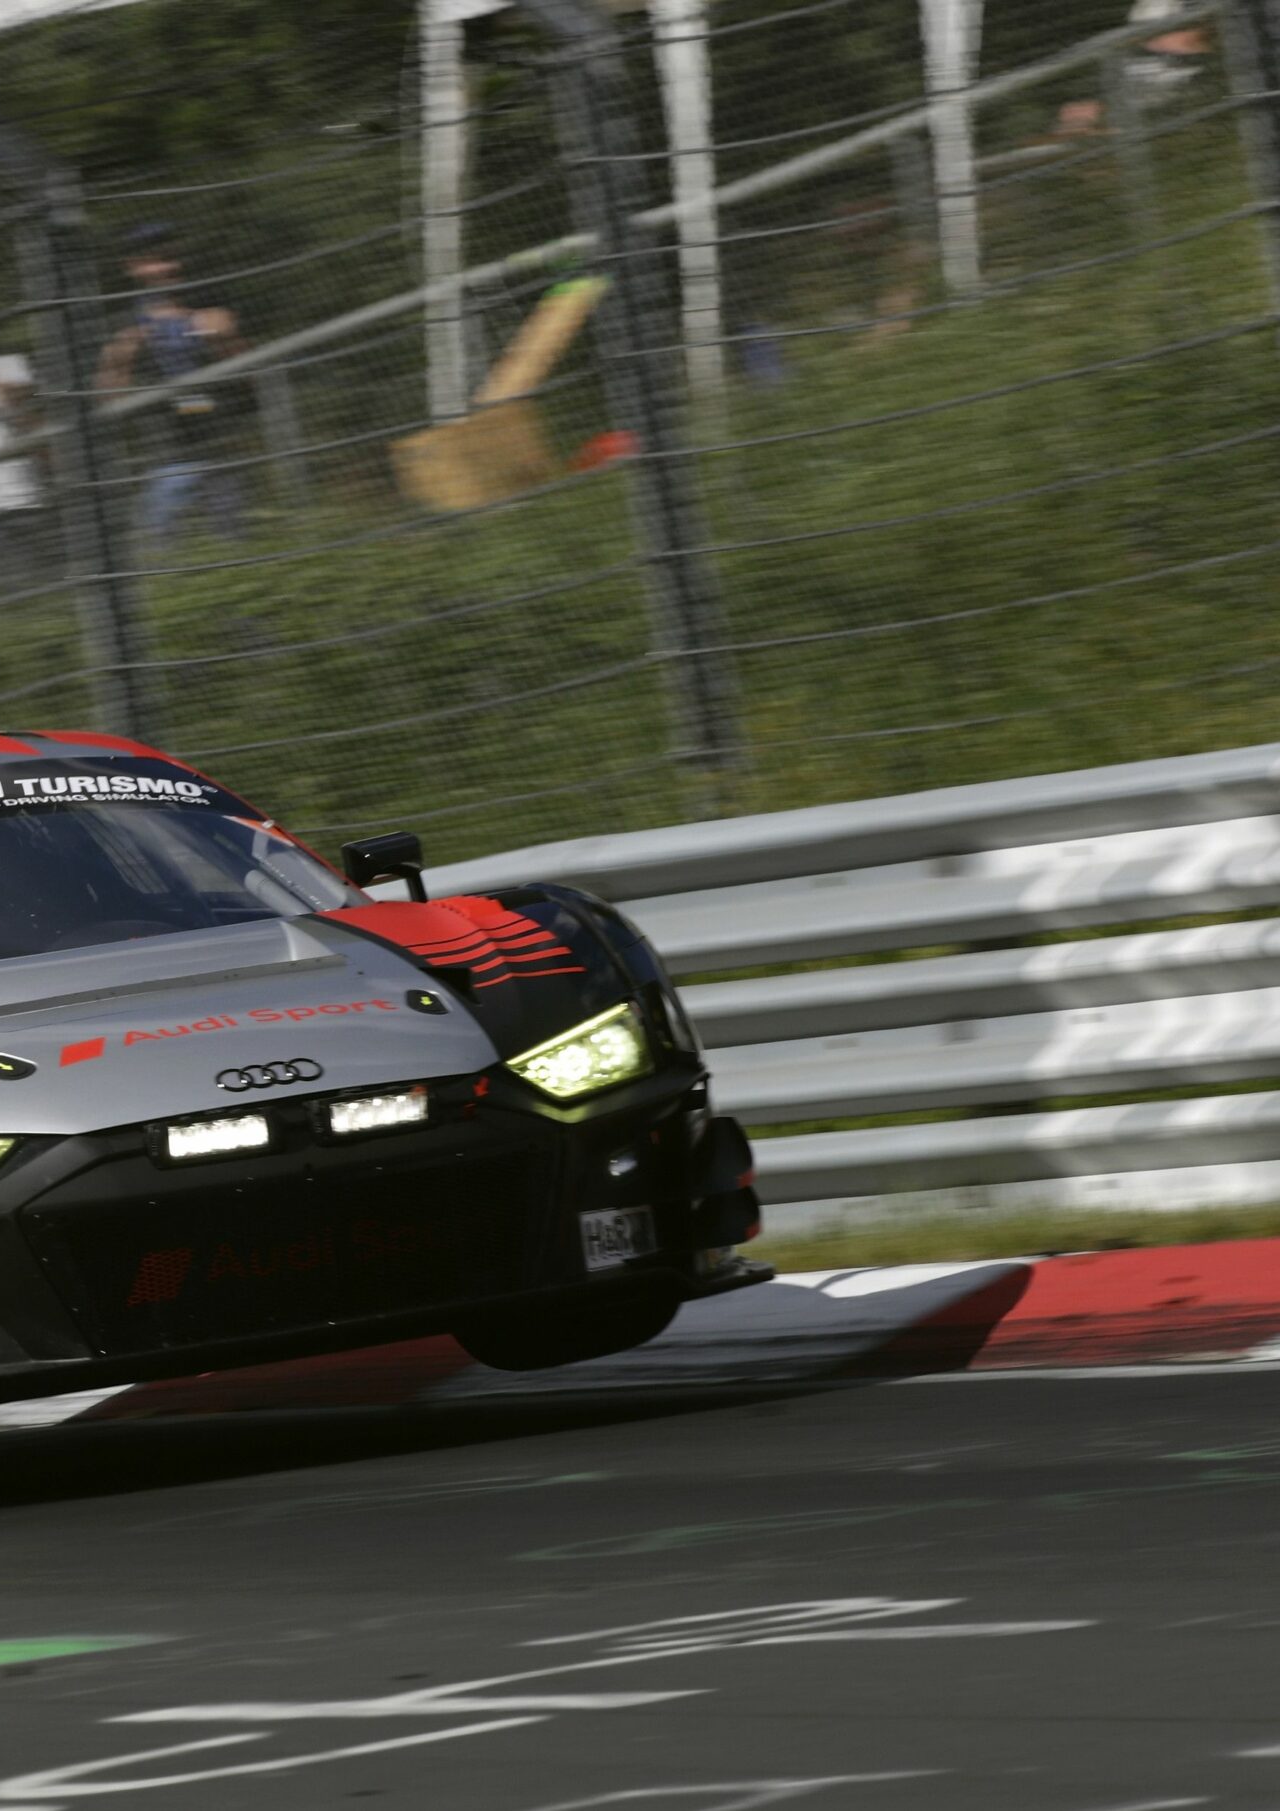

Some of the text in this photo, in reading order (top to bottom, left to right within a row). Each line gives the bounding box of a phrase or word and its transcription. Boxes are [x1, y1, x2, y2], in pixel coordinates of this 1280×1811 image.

[14, 775, 204, 797] TURISMO
[3, 794, 88, 806] DRIVING
[90, 794, 211, 806] SIMULATOR
[123, 998, 401, 1047] Audi Sport
